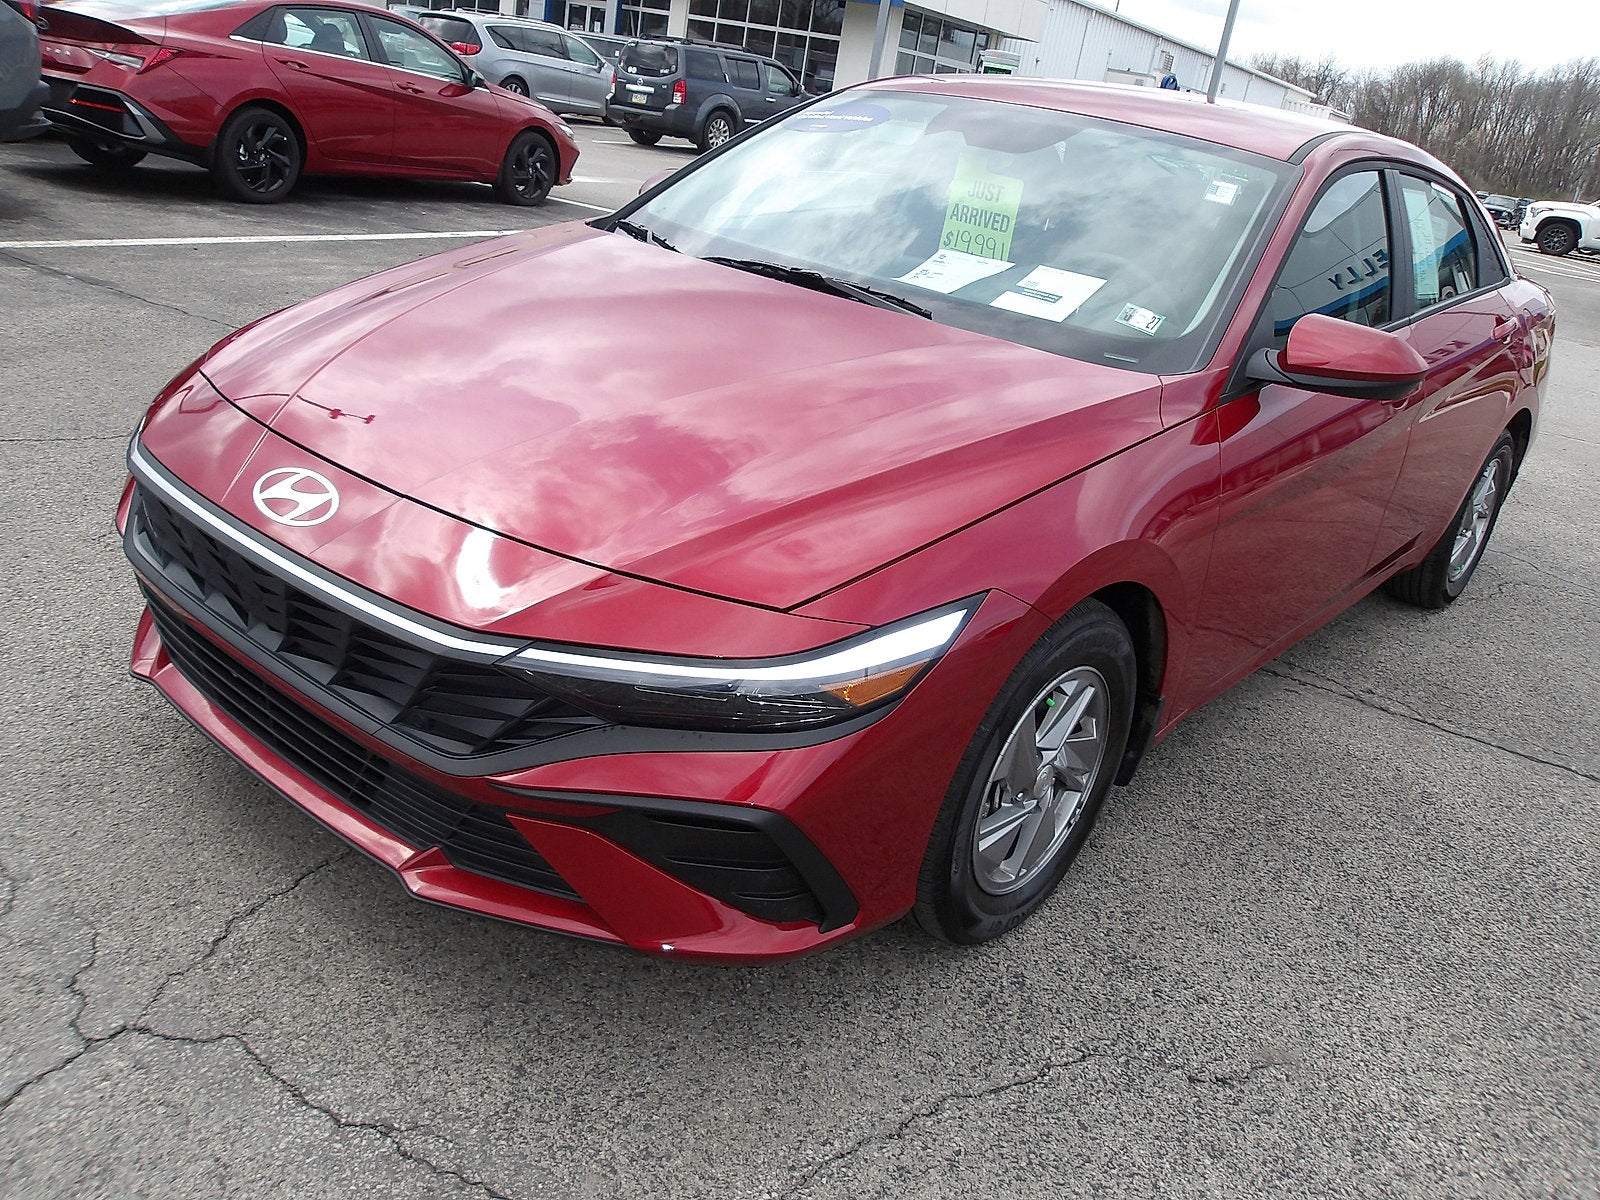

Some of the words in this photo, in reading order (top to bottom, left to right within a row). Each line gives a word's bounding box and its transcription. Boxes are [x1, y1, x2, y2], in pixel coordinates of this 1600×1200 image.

[968, 180, 1005, 203] JUST
[949, 203, 1010, 233] ARRIVED
[1145, 316, 1161, 330] 27
